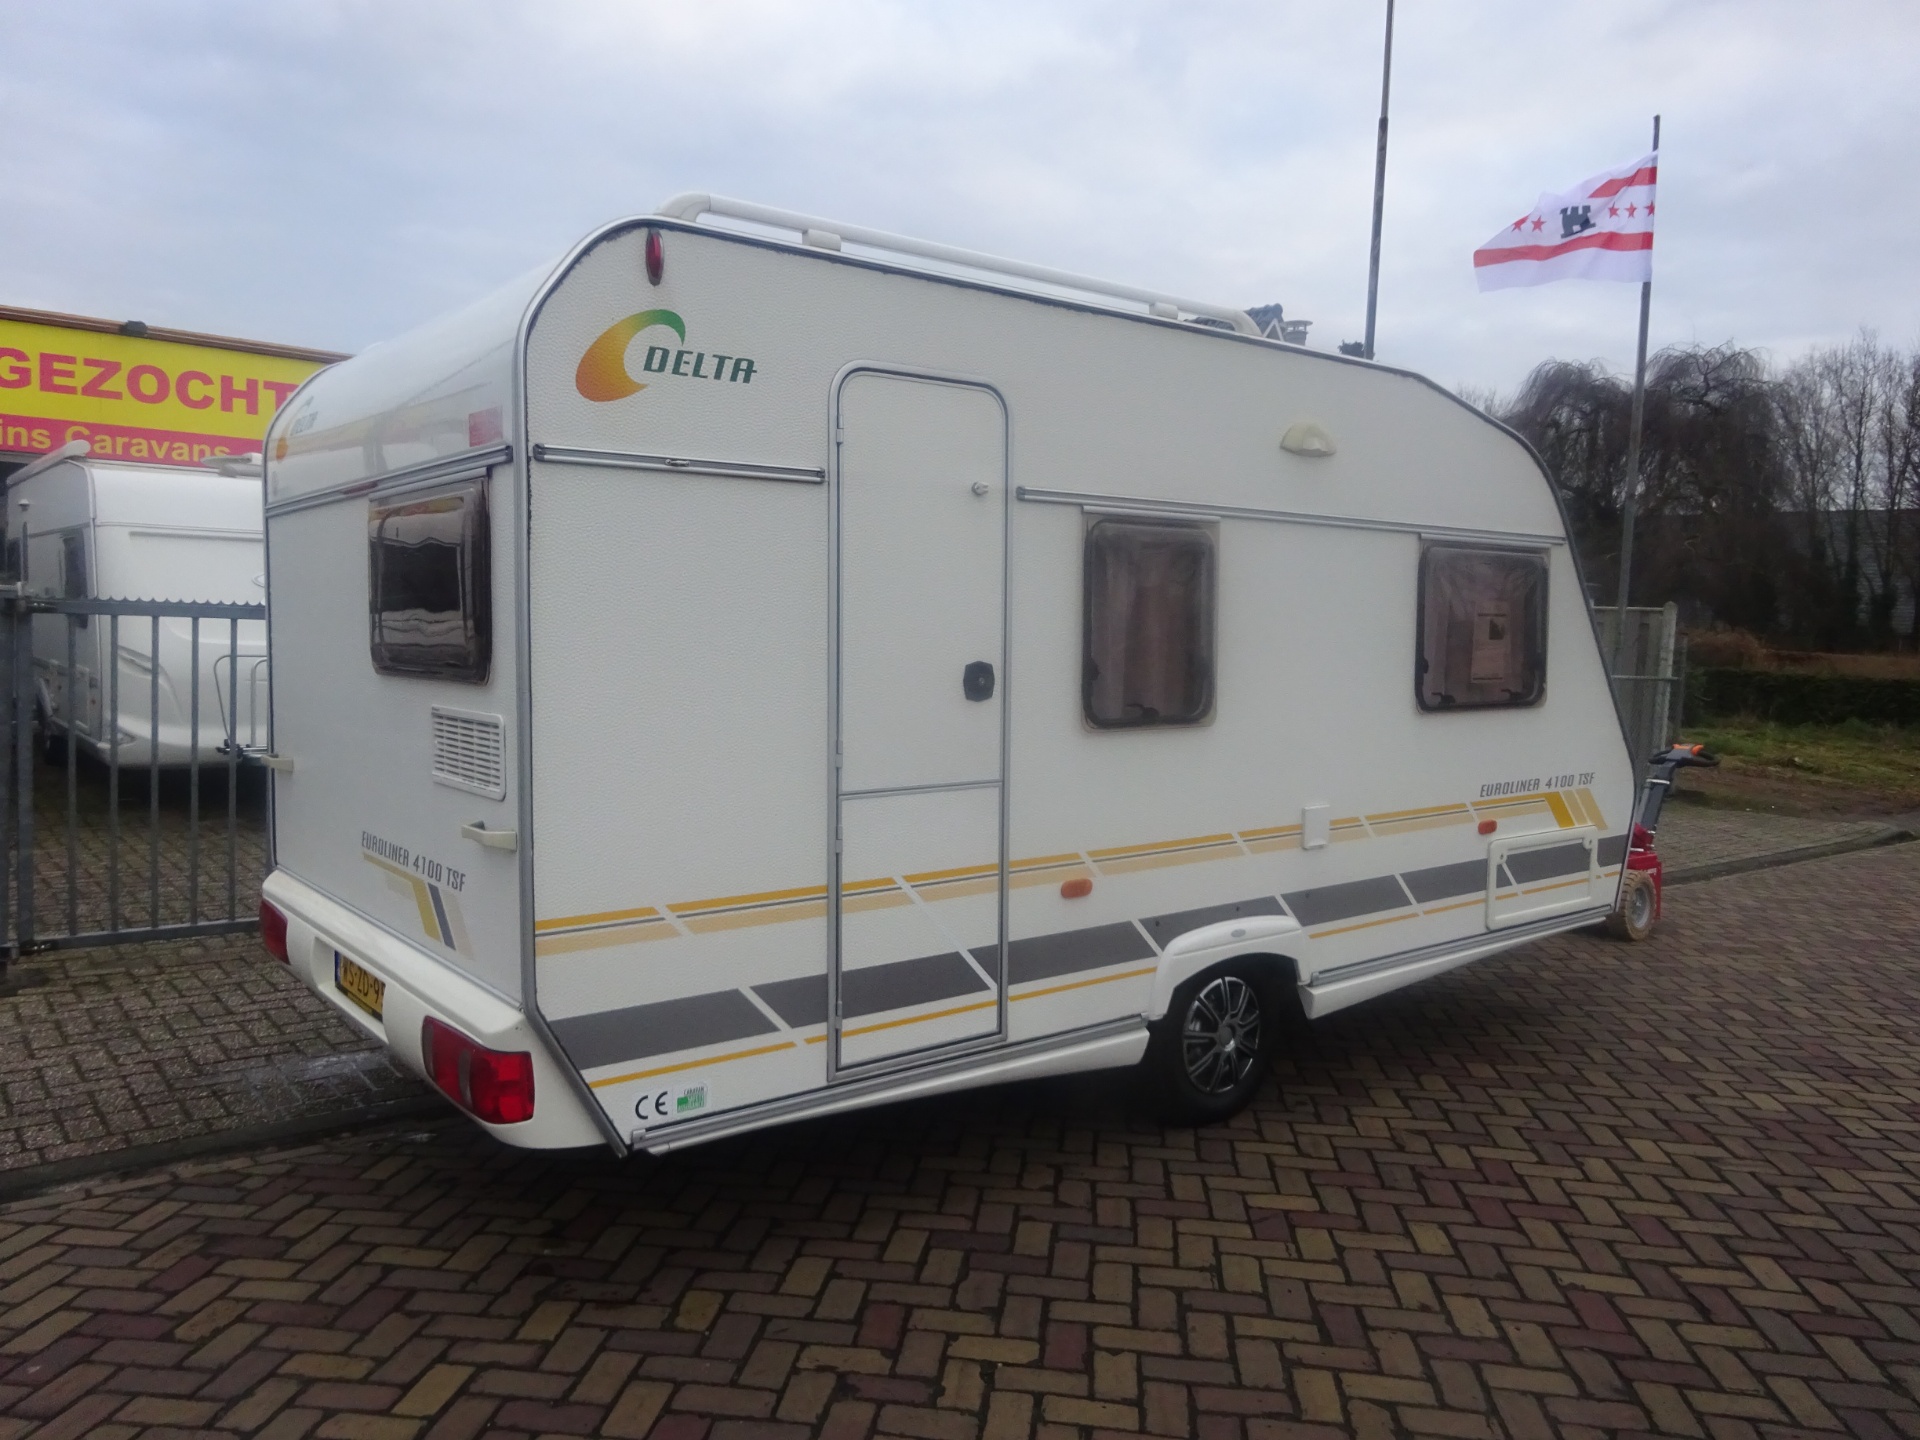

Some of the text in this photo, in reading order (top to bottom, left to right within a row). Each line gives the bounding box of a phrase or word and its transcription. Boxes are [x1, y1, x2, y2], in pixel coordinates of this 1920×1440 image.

[0, 347, 300, 415] GEZOCHT
[643, 345, 758, 384] DELTA
[64, 425, 231, 462] Caravans
[1480, 771, 1596, 798] EUROLINER 4100 TSF
[361, 830, 466, 892] EUROLINER 4100 TSF
[635, 1090, 668, 1120] CE
